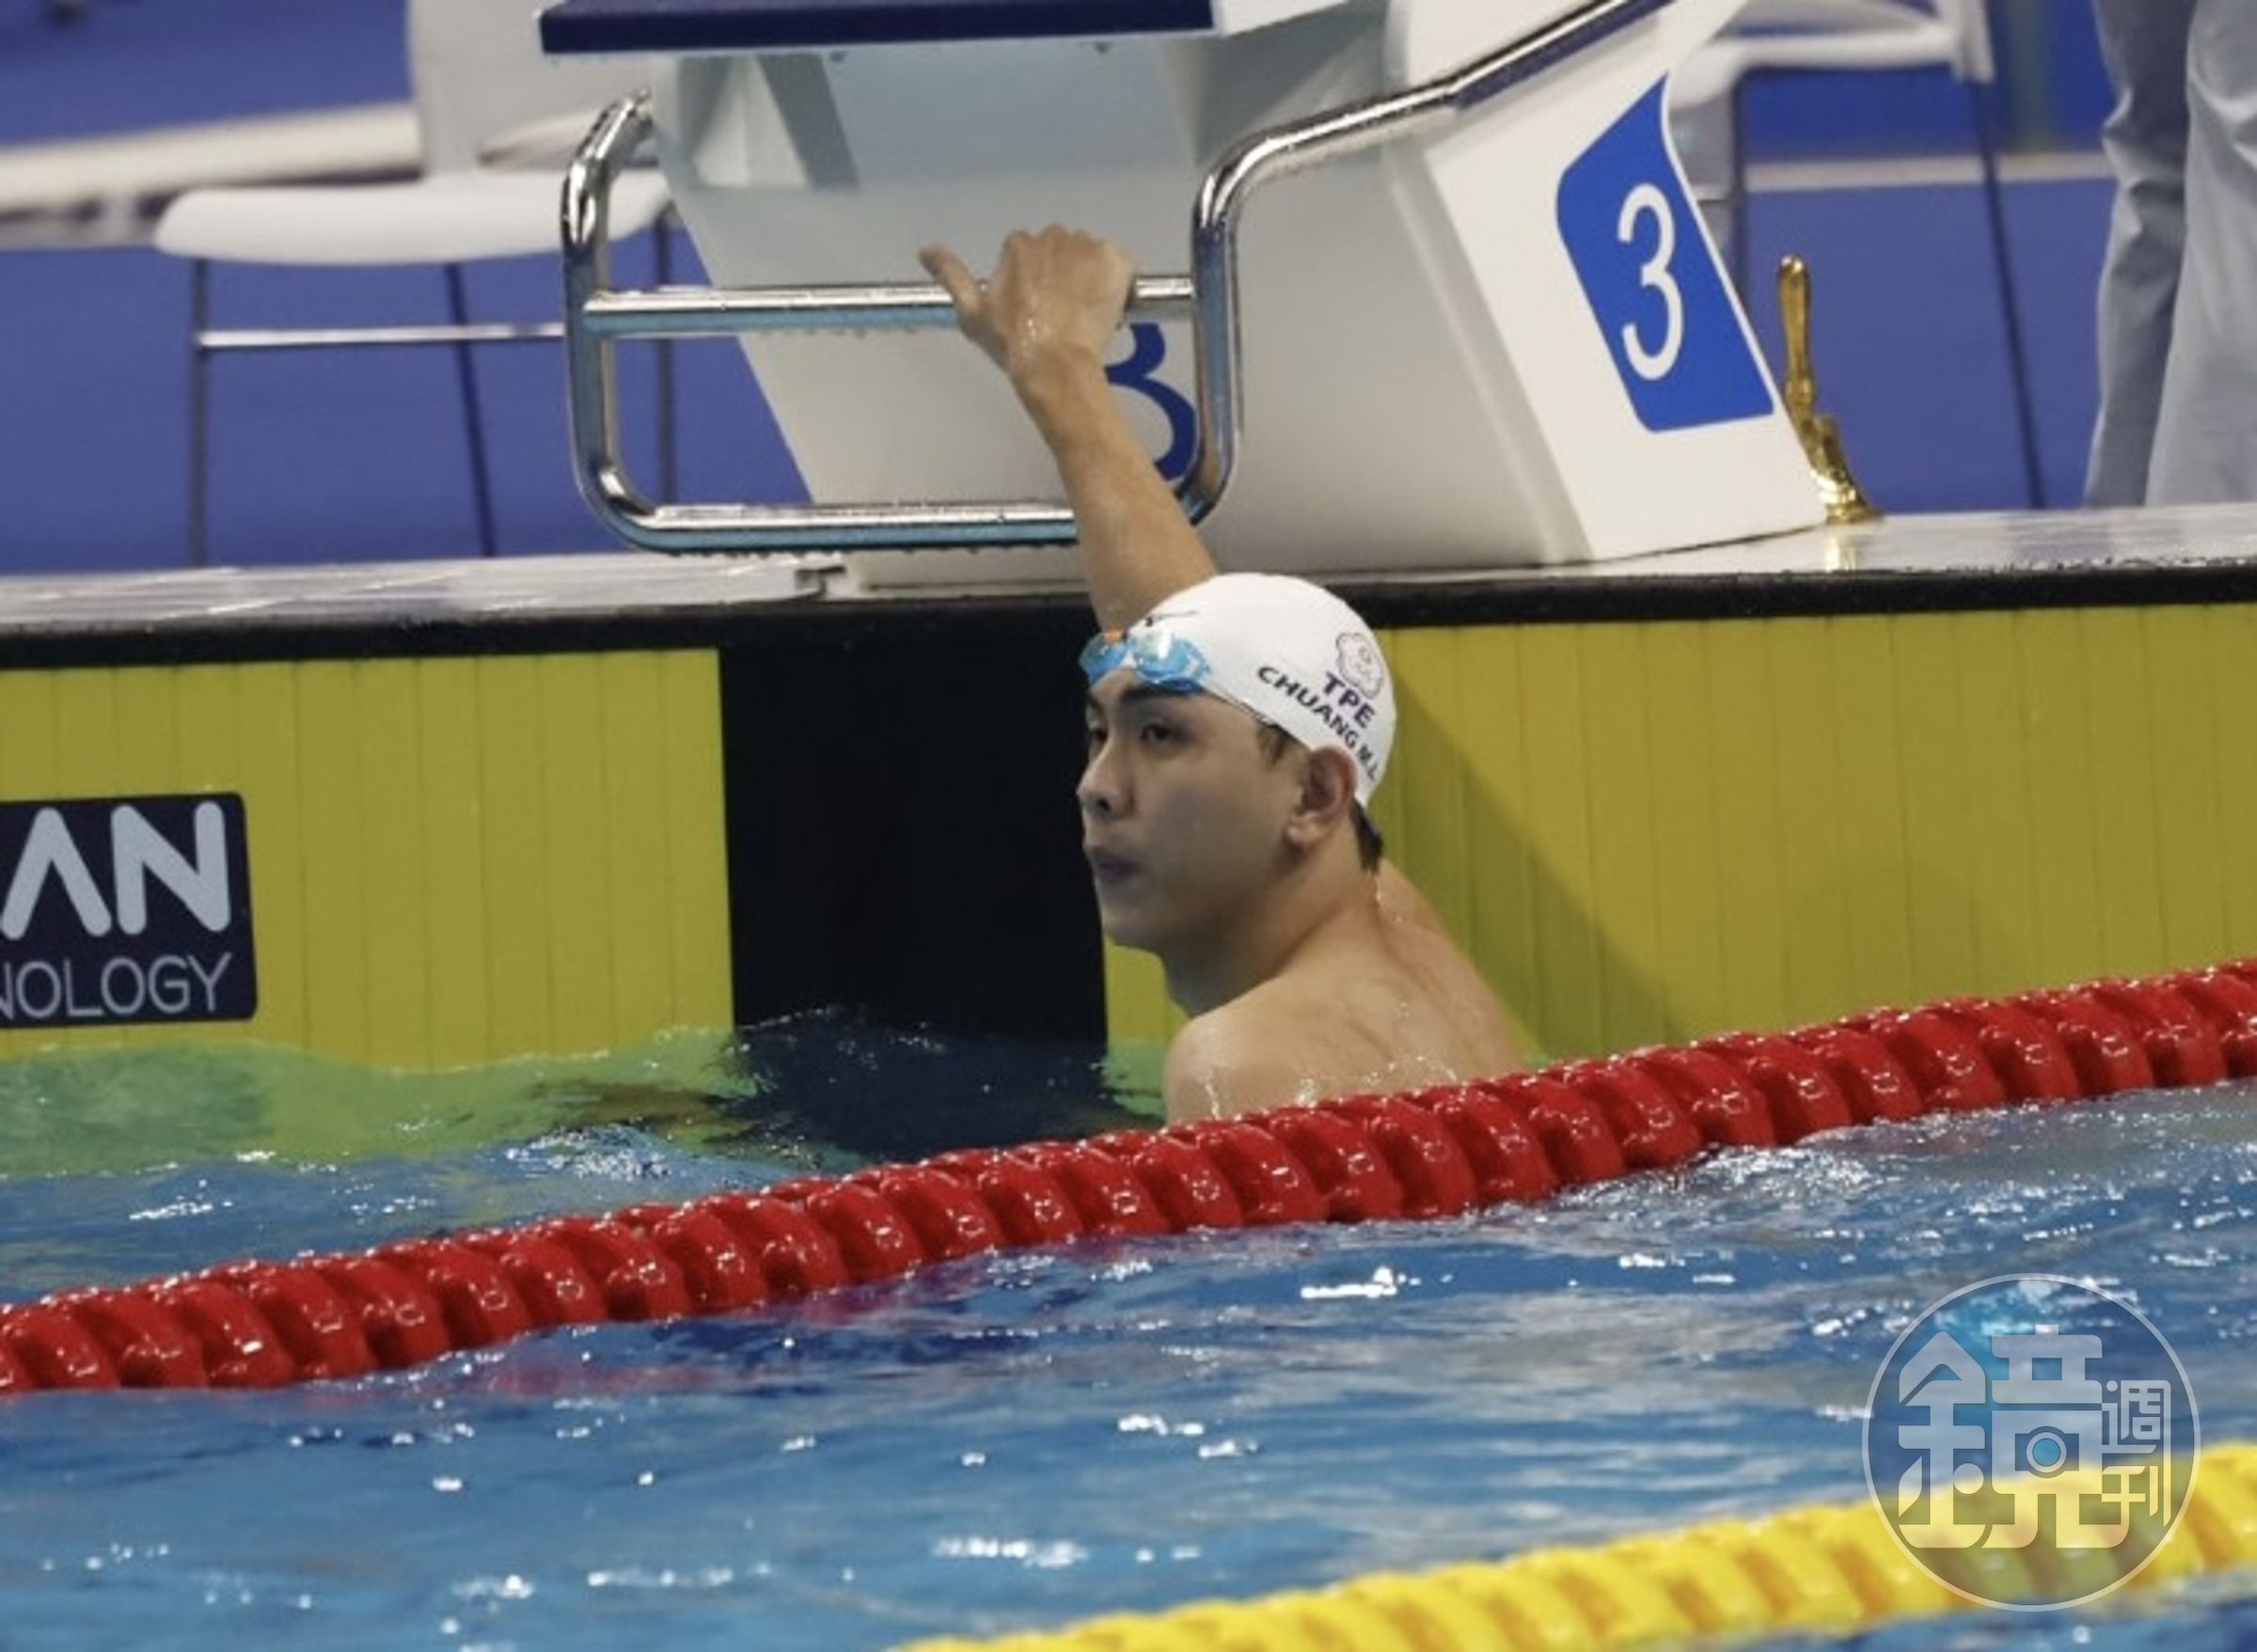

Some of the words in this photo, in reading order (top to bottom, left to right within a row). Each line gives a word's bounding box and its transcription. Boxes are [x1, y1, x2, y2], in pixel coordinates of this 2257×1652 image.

[1617, 183, 1685, 380] 3
[1104, 322, 1196, 480] 3
[1258, 666, 1358, 748] CHUANG
[1323, 671, 1374, 729] TPE
